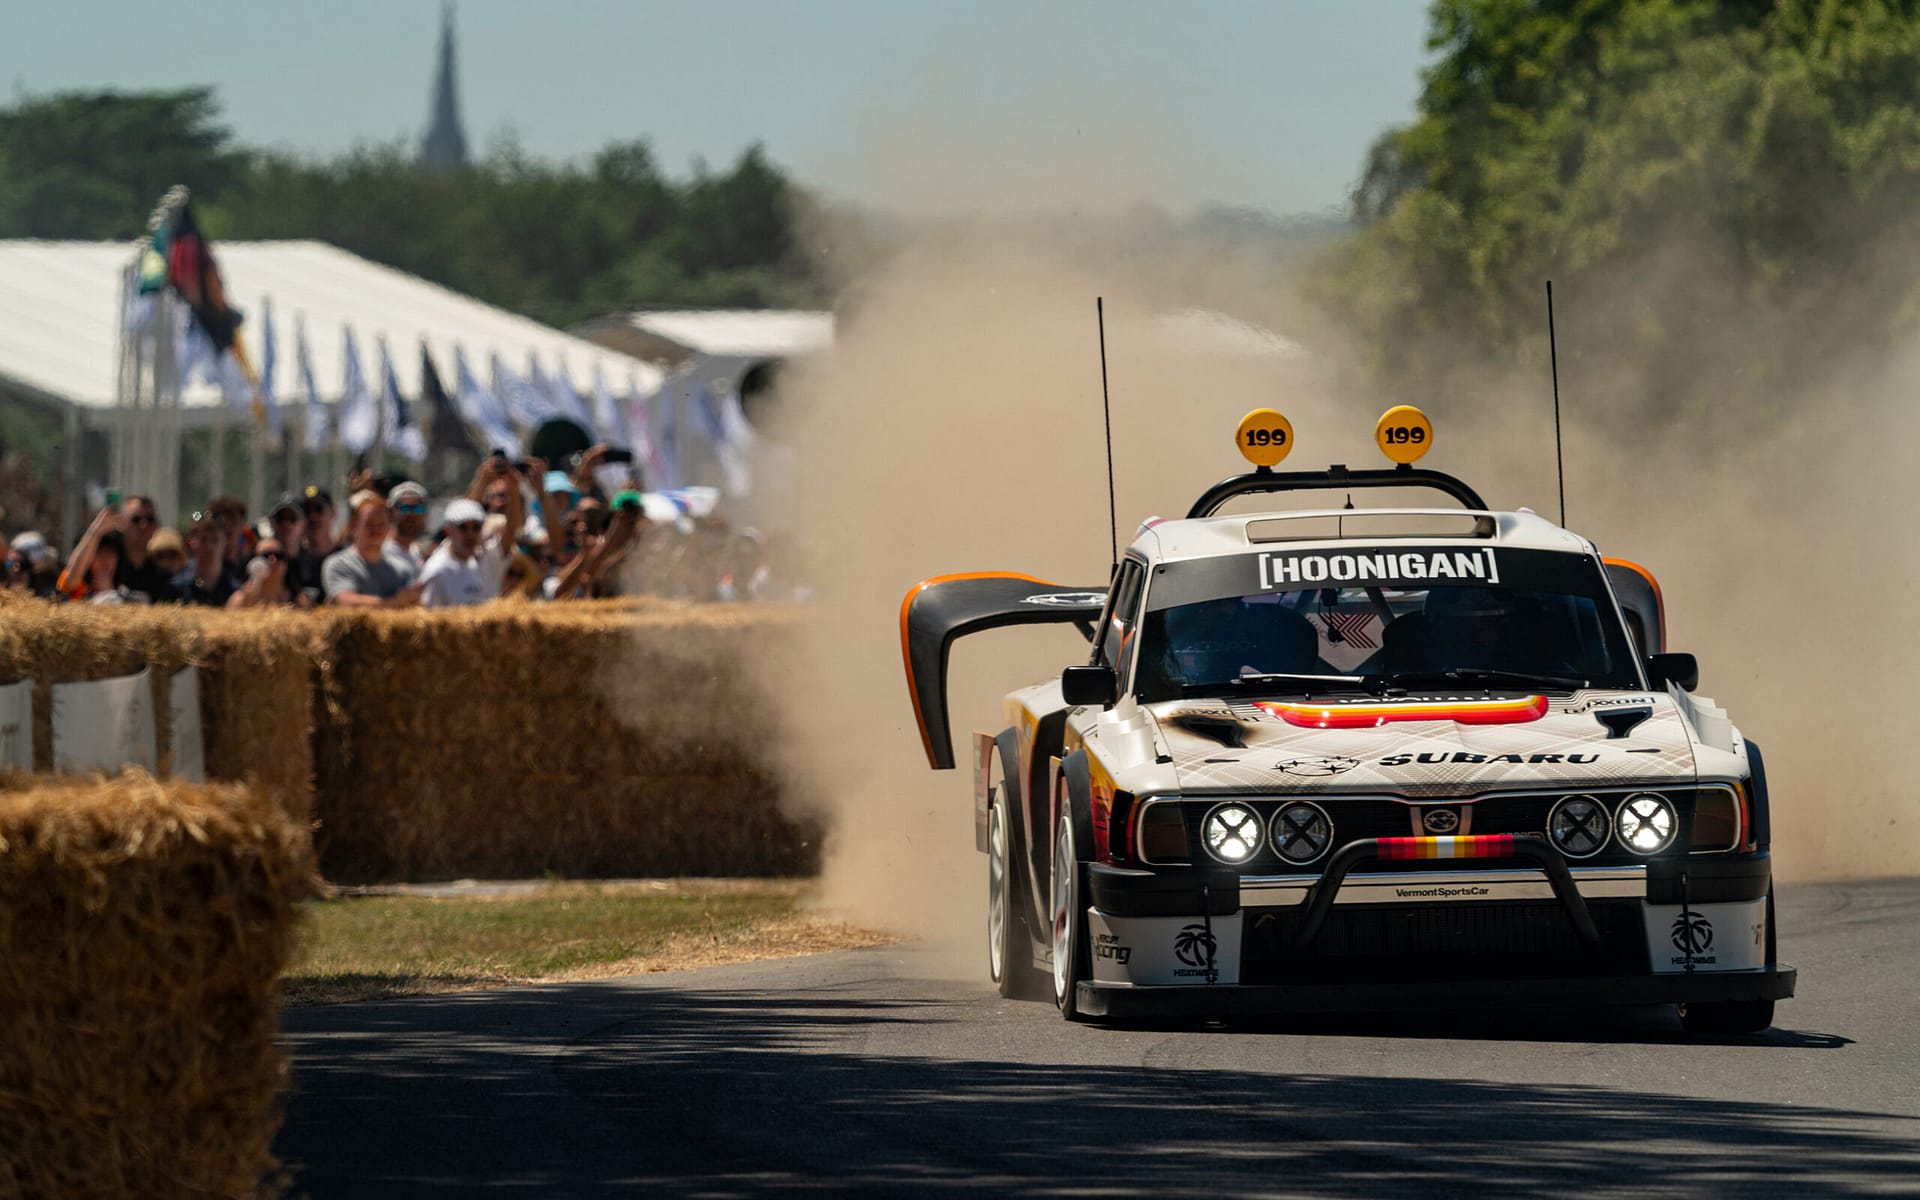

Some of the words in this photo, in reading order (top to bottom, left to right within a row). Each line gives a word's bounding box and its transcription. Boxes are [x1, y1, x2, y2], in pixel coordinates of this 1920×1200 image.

[1246, 429, 1286, 446] 199
[1385, 427, 1425, 444] 199
[1379, 752, 1600, 766] SUBARU
